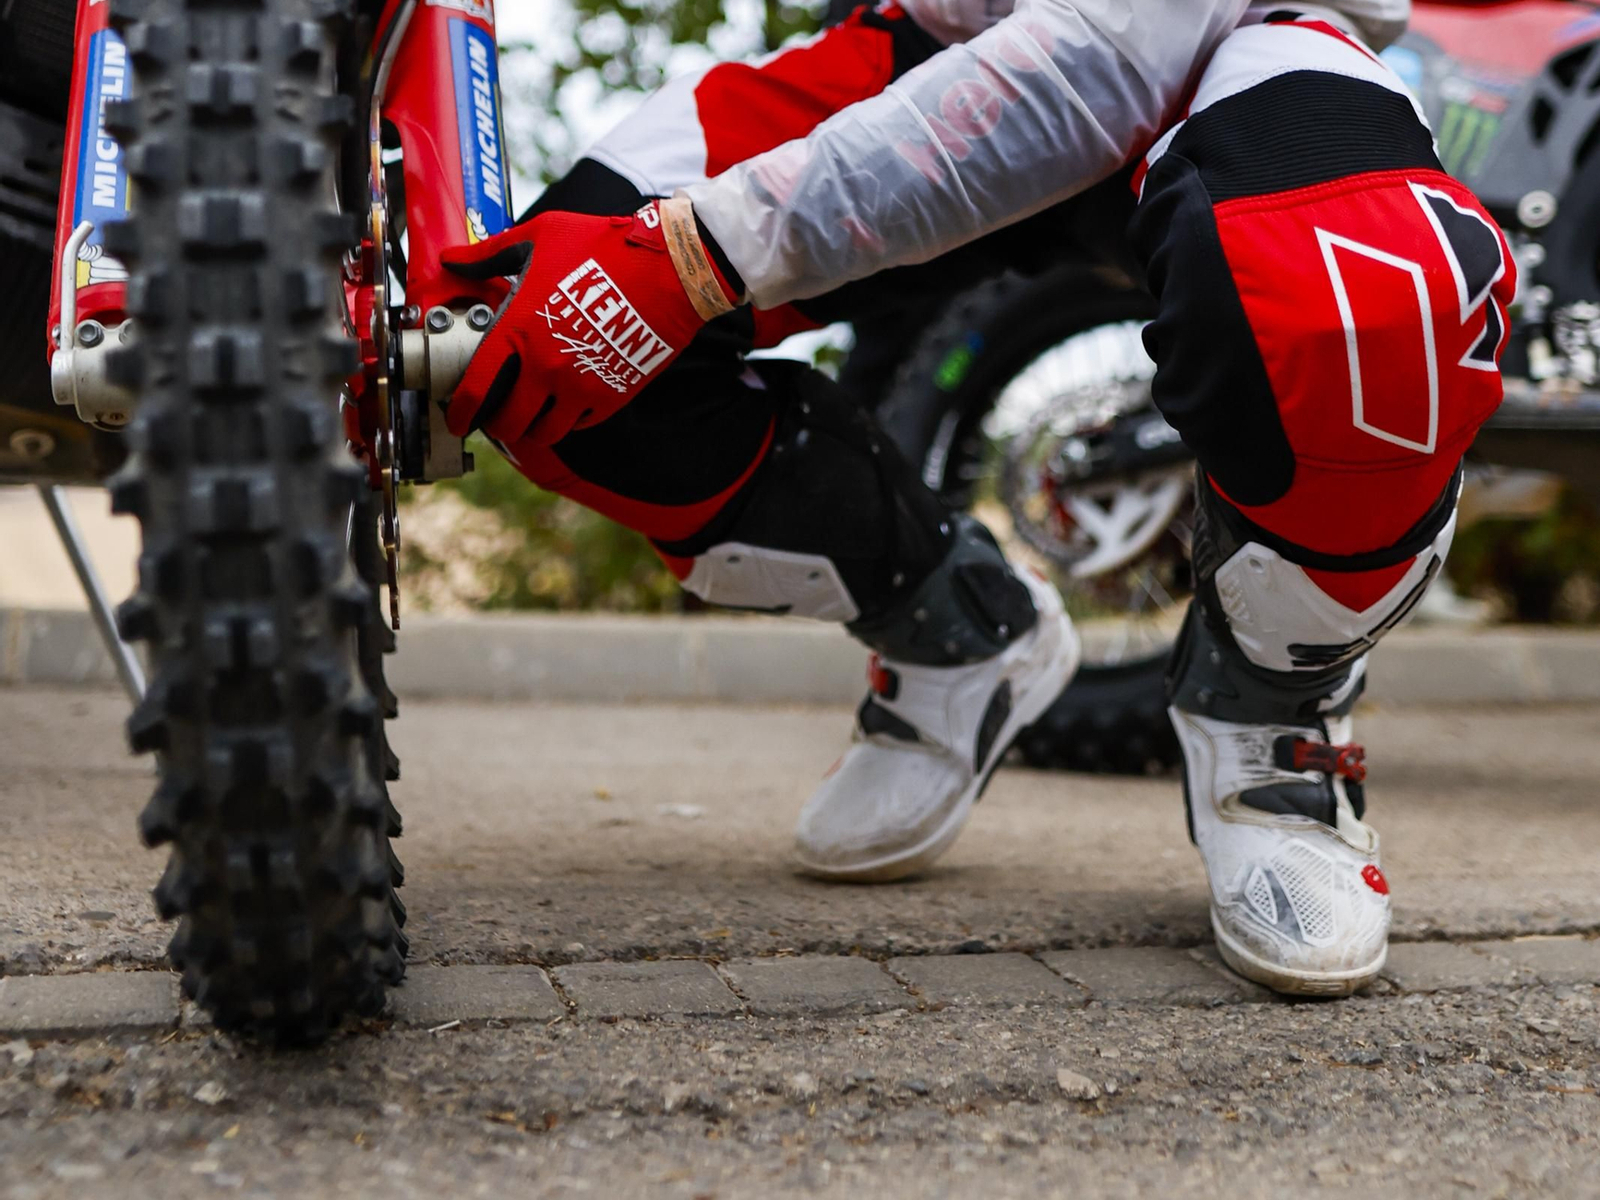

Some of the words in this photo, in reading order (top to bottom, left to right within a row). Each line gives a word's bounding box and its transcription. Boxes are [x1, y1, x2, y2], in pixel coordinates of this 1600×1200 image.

[467, 35, 503, 207] MICHELIN
[547, 291, 642, 386] UNLIMITED
[566, 264, 668, 374] KENNY
